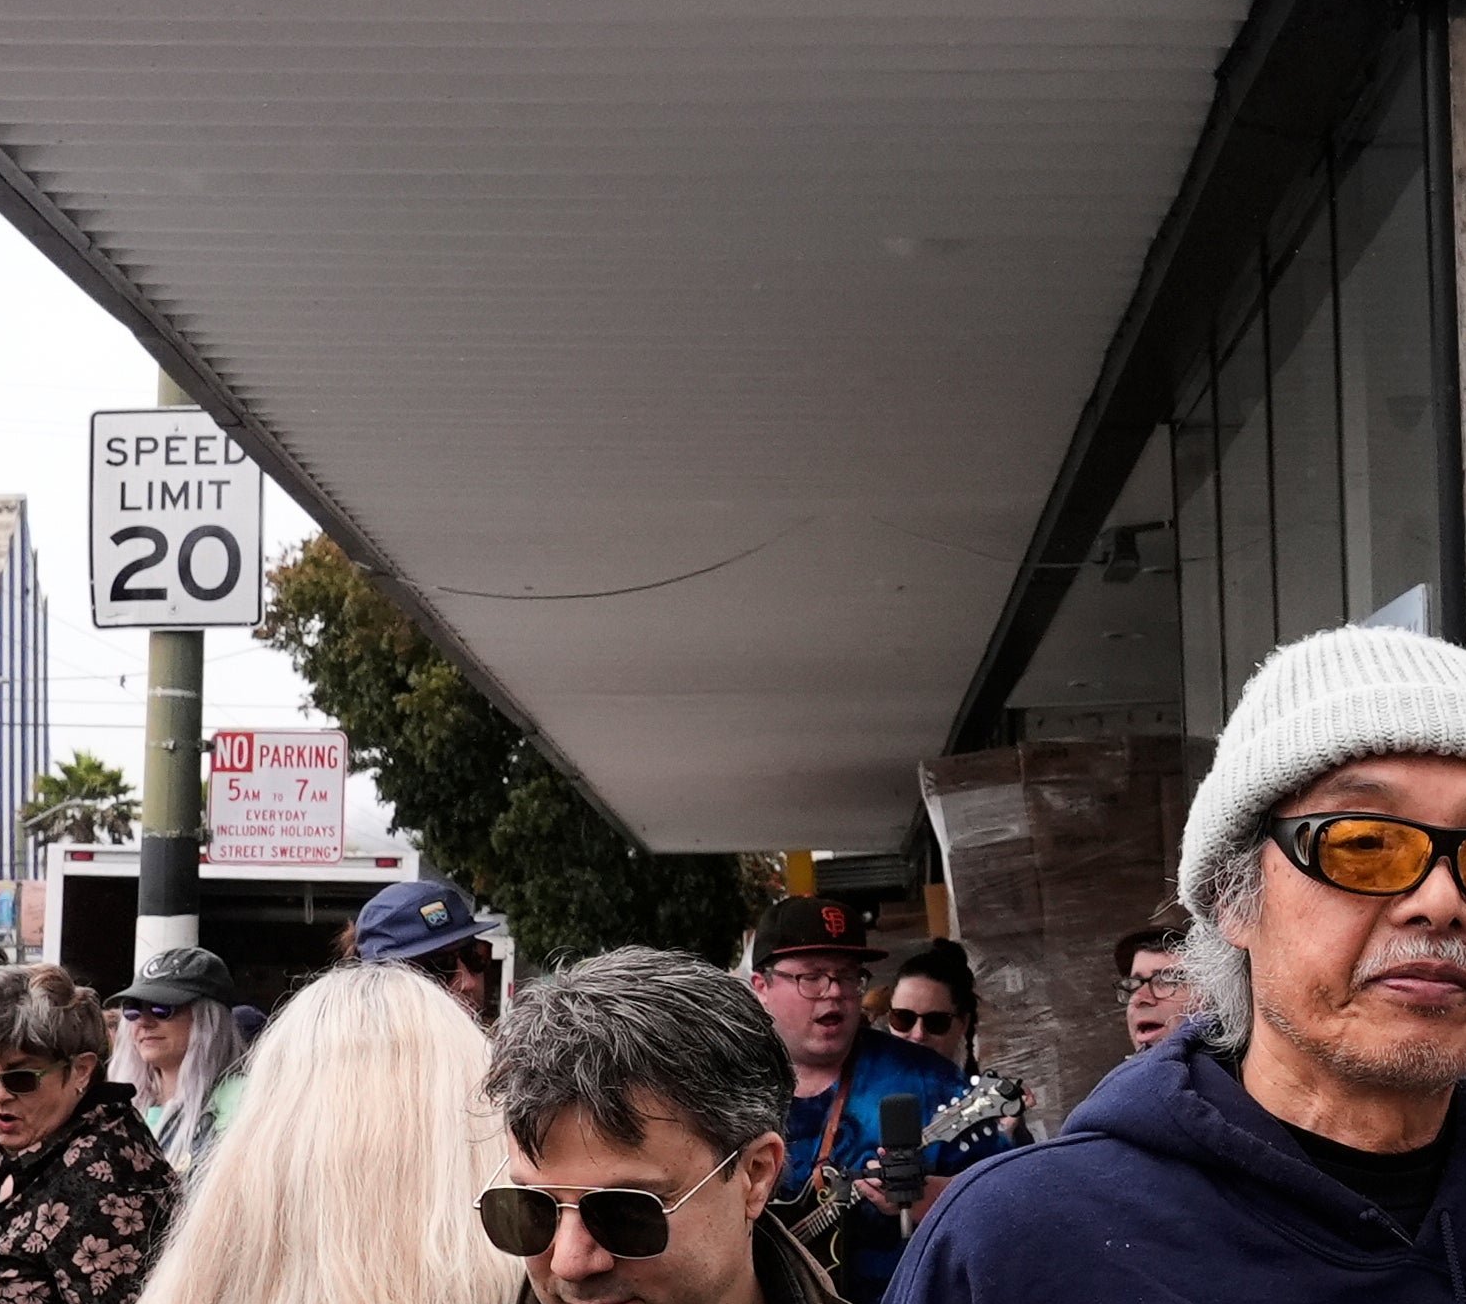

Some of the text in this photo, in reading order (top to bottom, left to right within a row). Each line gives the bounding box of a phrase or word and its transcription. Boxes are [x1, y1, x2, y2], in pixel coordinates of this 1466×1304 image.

[105, 435, 247, 468] SPEED
[120, 479, 231, 512] LIMIT
[109, 525, 241, 603] 20
[215, 735, 338, 769] NO PARKING
[217, 825, 335, 838] INCLUDING HOLIDAYS
[246, 809, 307, 821] EVERYDAY
[220, 846, 264, 858] STREET
